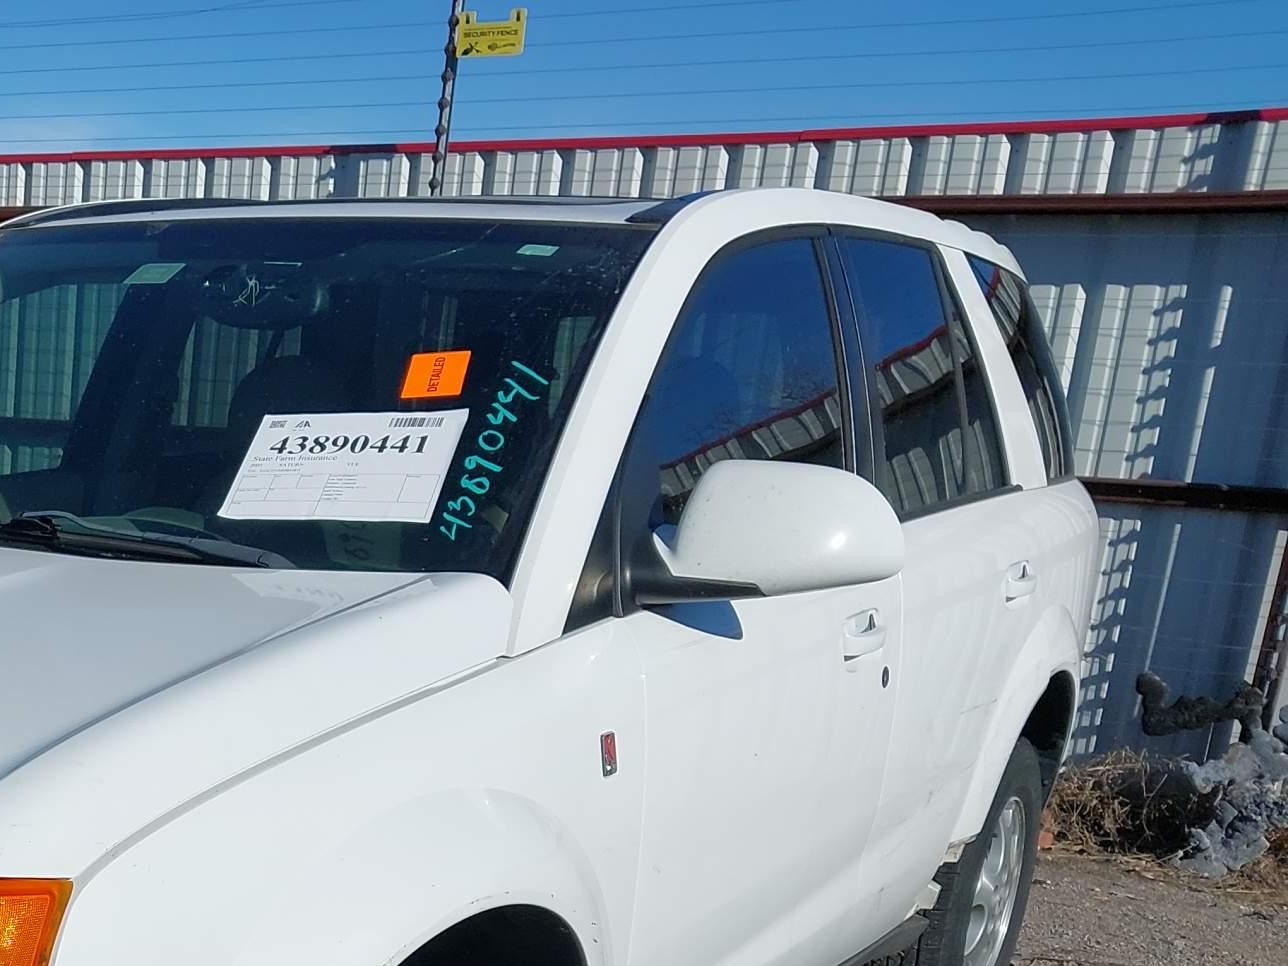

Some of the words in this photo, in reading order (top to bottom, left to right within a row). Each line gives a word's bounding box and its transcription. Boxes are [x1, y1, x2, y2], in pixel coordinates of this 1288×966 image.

[427, 357, 446, 392] DETAILED
[269, 434, 429, 455] 43890441
[440, 360, 549, 541] 43890441
